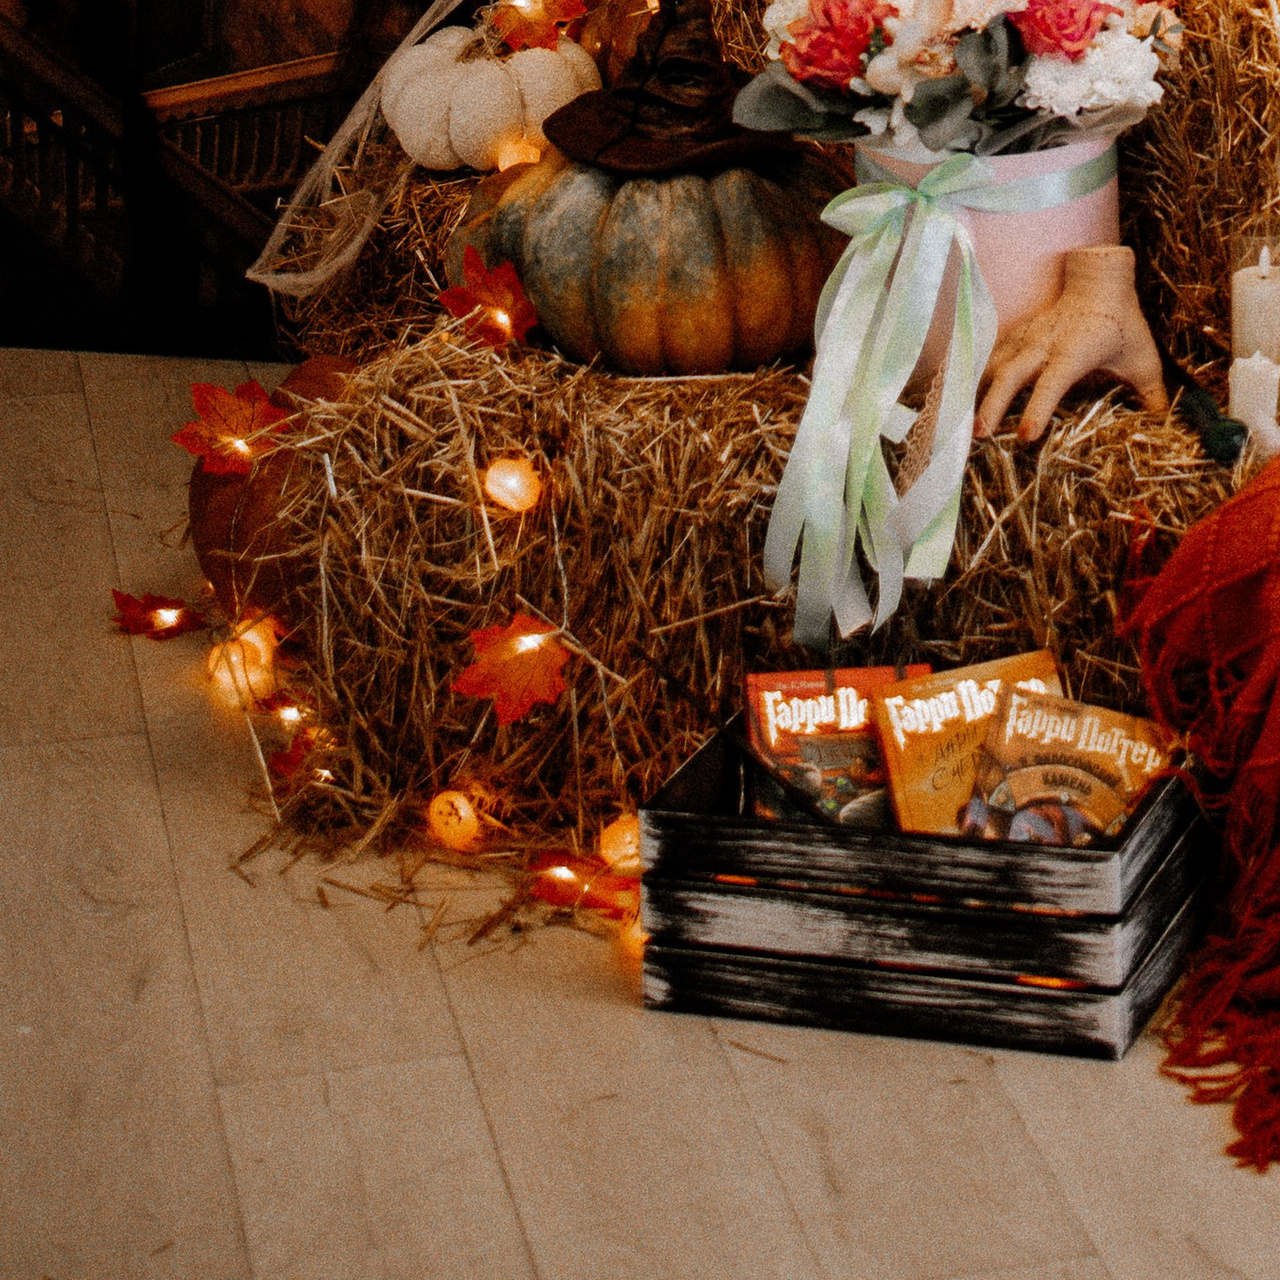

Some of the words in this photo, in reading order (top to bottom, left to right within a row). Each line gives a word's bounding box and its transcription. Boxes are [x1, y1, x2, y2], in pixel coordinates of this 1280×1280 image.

[763, 689, 837, 747] Гарри
[884, 691, 960, 751] Гарри
[1005, 693, 1078, 746] Гарри
[1076, 714, 1162, 773] Поттер
